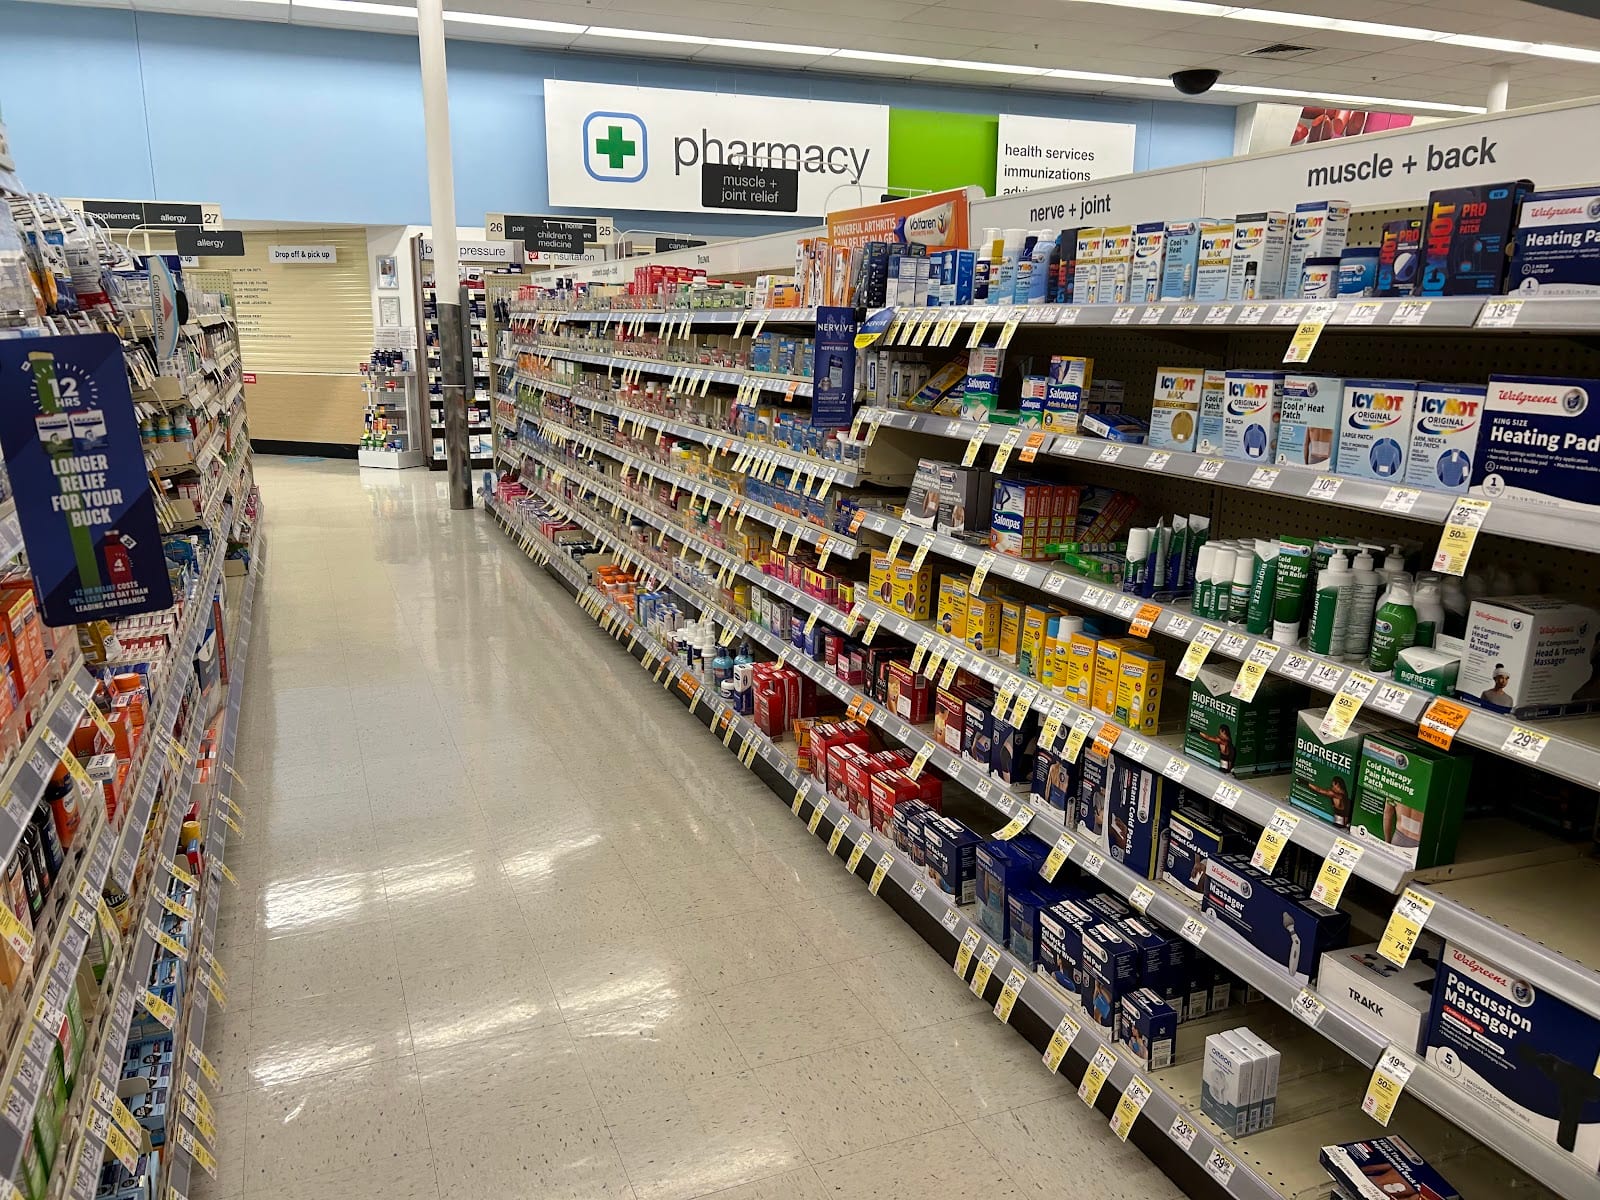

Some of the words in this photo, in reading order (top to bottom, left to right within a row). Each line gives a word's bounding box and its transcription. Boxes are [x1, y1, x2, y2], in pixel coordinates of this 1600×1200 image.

[674, 127, 870, 185] pharmacy
[1005, 144, 1042, 159] health
[1046, 148, 1095, 162] services
[1307, 152, 1394, 187] muscle
[1426, 136, 1497, 172] back
[1004, 164, 1091, 182] immunizations
[723, 174, 766, 188] muscle
[721, 188, 747, 204] joint
[751, 190, 779, 204] relief
[1030, 203, 1065, 222] nerve
[1080, 194, 1111, 220] joint
[1462, 202, 1488, 217] PRO
[1531, 206, 1584, 220] Walgreens
[160, 214, 187, 224] allergy
[204, 214, 218, 224] 27
[834, 222, 862, 236] POWERFUL
[864, 216, 896, 232] ARTHRITIS
[909, 216, 936, 231] Voltaren
[490, 222, 503, 232] 26
[599, 226, 611, 236] 25
[1460, 224, 1480, 234] PATCH
[537, 230, 572, 240] children's
[1399, 230, 1420, 242] PRO
[1526, 232, 1582, 248] Heating
[1584, 230, 1600, 243] Pa
[196, 238, 224, 248] allergy
[538, 240, 572, 249] medicine
[275, 251, 290, 260] Drop
[307, 251, 320, 260] pick
[460, 247, 506, 256] pressure
[152, 274, 162, 306] Customer
[155, 307, 164, 341] Service
[818, 323, 854, 332] NERVIVE
[48, 378, 79, 398] 12
[966, 378, 992, 390] Salonpas
[1048, 388, 1078, 401] Salonpas
[1498, 390, 1558, 406] Walgreens
[55, 398, 81, 408] HRS
[1022, 400, 1041, 409] Salonpas
[1283, 402, 1298, 411] Cool
[1307, 404, 1324, 413] Heat
[1283, 410, 1300, 420] Patch
[1358, 412, 1392, 422] ORIGINAL
[1428, 416, 1464, 426] ORIGINAL
[1512, 419, 1528, 427] SIZE
[1490, 427, 1561, 452] Heating
[1564, 434, 1600, 452] Pad
[50, 454, 109, 476] LONGER
[60, 472, 107, 492] RELIEF
[51, 493, 81, 512] FOR
[83, 488, 123, 508] YOUR
[70, 509, 112, 528] BUCK
[994, 513, 1020, 530] Salonpas
[113, 558, 123, 568] 4
[116, 580, 138, 590] COSTS
[102, 592, 116, 600] PER
[116, 590, 130, 598] DAY
[131, 587, 149, 596] THAN
[75, 603, 104, 612] LEADING
[119, 596, 146, 606] BRANDS
[1472, 631, 1489, 640] Head
[1481, 627, 1514, 639] Compression
[1469, 643, 1499, 657] Massager
[1477, 639, 1500, 651] Temple
[1536, 649, 1554, 658] Head
[1560, 646, 1586, 657] Temple
[1534, 658, 1566, 667] Massager
[1190, 708, 1205, 717] LARGE
[1425, 713, 1458, 730] CLEARANCE
[1295, 762, 1317, 775] PATCHES
[1296, 757, 1313, 767] LARGE
[1366, 760, 1382, 771] Cold
[1383, 766, 1412, 785] Therapy
[1130, 772, 1139, 805] Instant
[1363, 775, 1383, 788] Patch
[1365, 768, 1380, 779] Pain
[1381, 774, 1415, 796] Relieving
[1128, 806, 1136, 828] Cold
[1360, 827, 1365, 836] 5
[1126, 829, 1134, 855] Packs
[1211, 865, 1240, 888] Walgreens
[1208, 882, 1245, 911] Massager
[1453, 949, 1508, 988] Walgreens
[1348, 987, 1384, 1017] TRAKK
[1447, 972, 1532, 1033] Percussion
[1444, 987, 1518, 1040] Massager
[1444, 1053, 1452, 1065] 5
